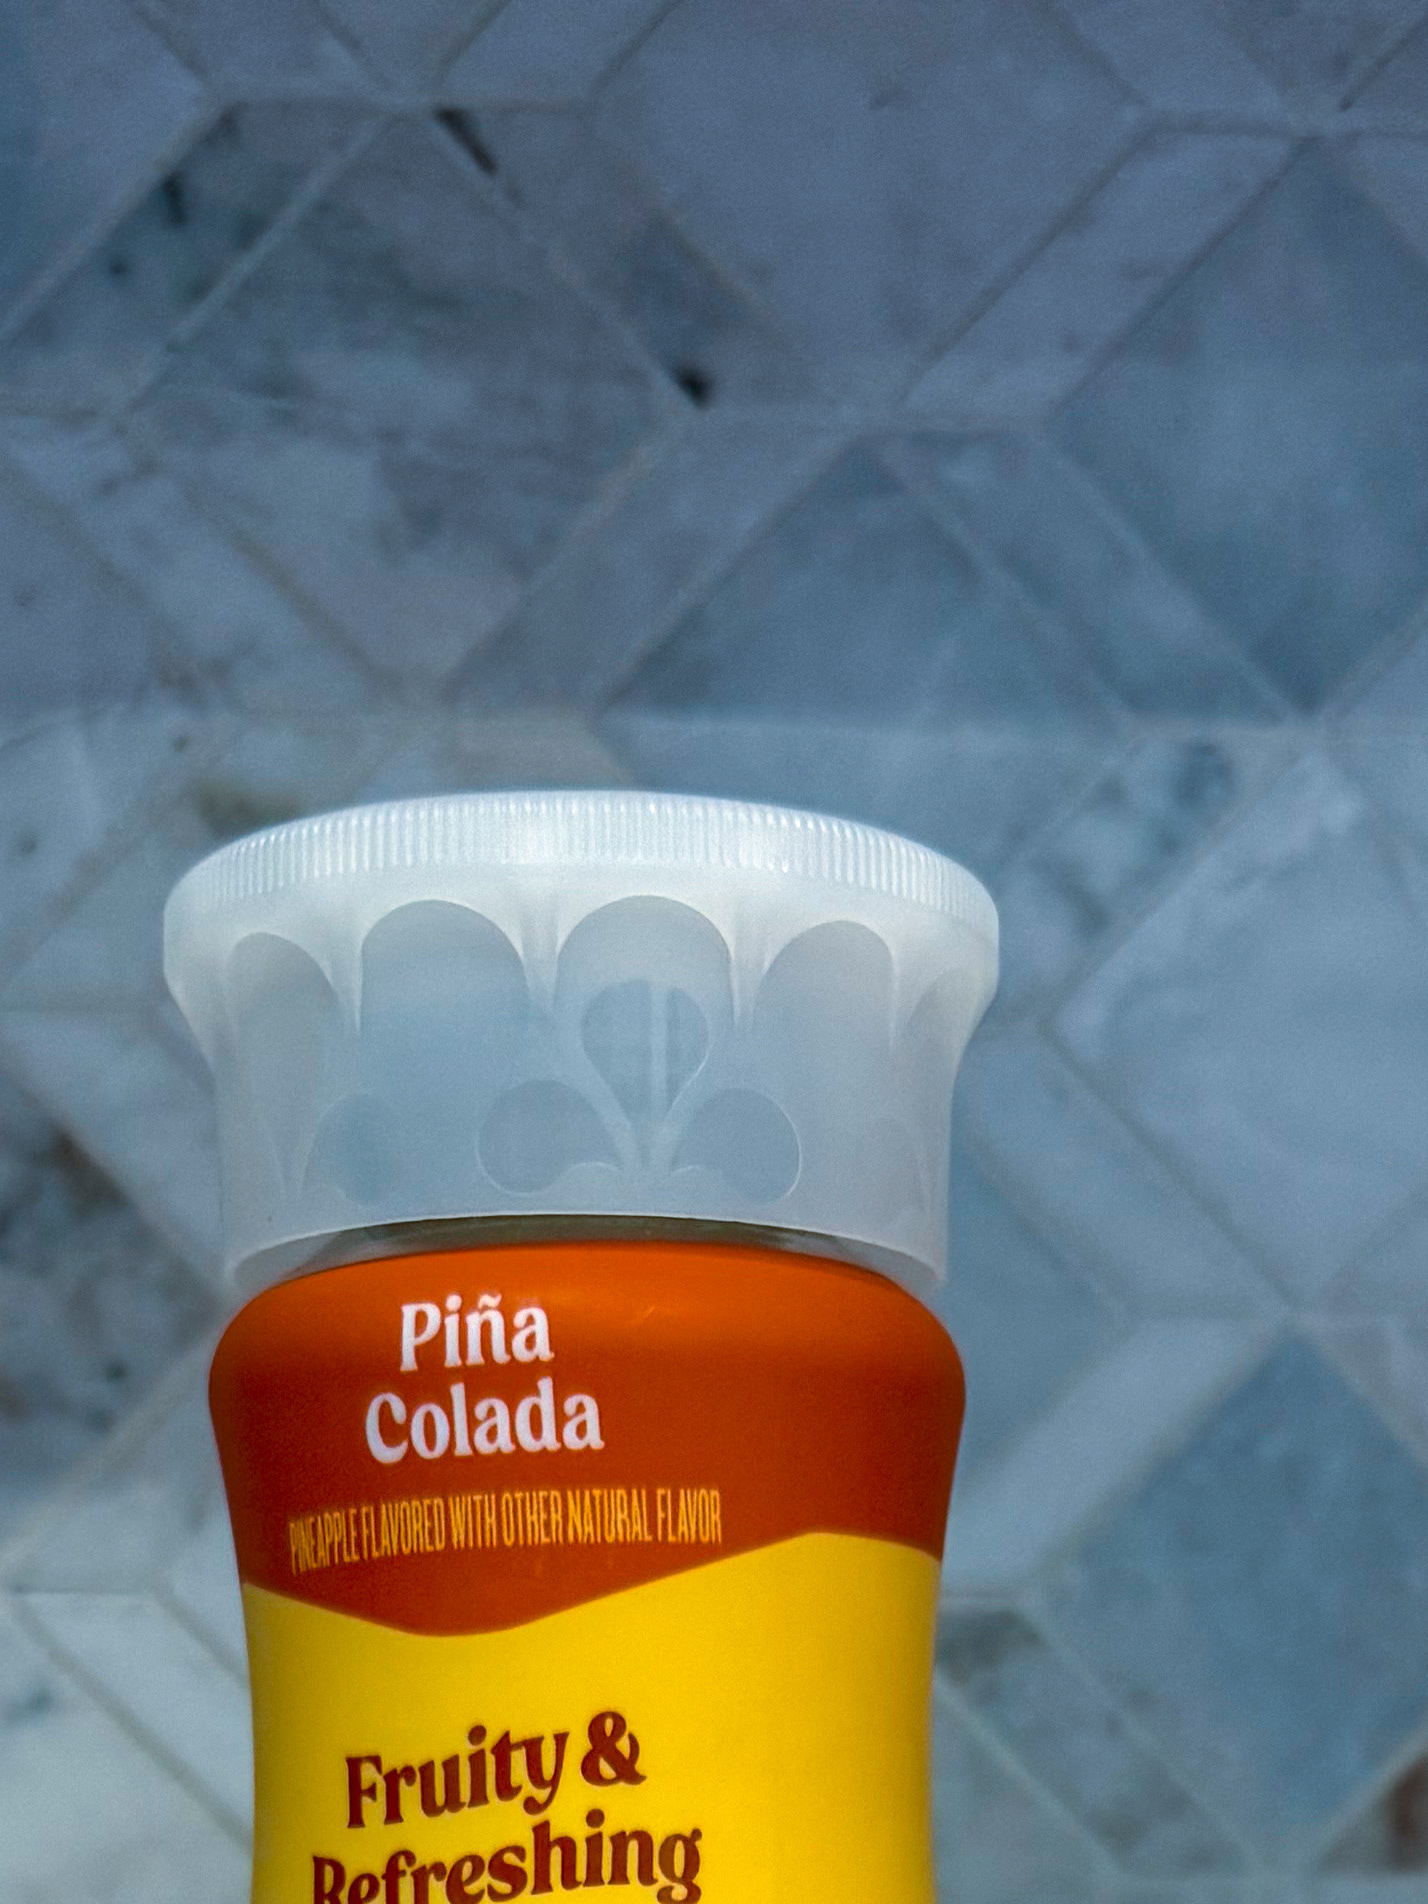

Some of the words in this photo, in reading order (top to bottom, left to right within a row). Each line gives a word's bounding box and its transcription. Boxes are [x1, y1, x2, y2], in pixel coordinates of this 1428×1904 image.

[400, 1293, 553, 1372] Piña
[365, 1378, 605, 1464] Colada
[289, 1507, 359, 1576] PINEAPPLE
[361, 1497, 445, 1560] FLAVORED
[448, 1493, 497, 1549] WITH
[501, 1490, 563, 1546] OTHER
[567, 1488, 653, 1544] NATURAL
[656, 1488, 721, 1544] FLAVOR
[344, 1725, 569, 1829] Fruity
[580, 1711, 647, 1787] &
